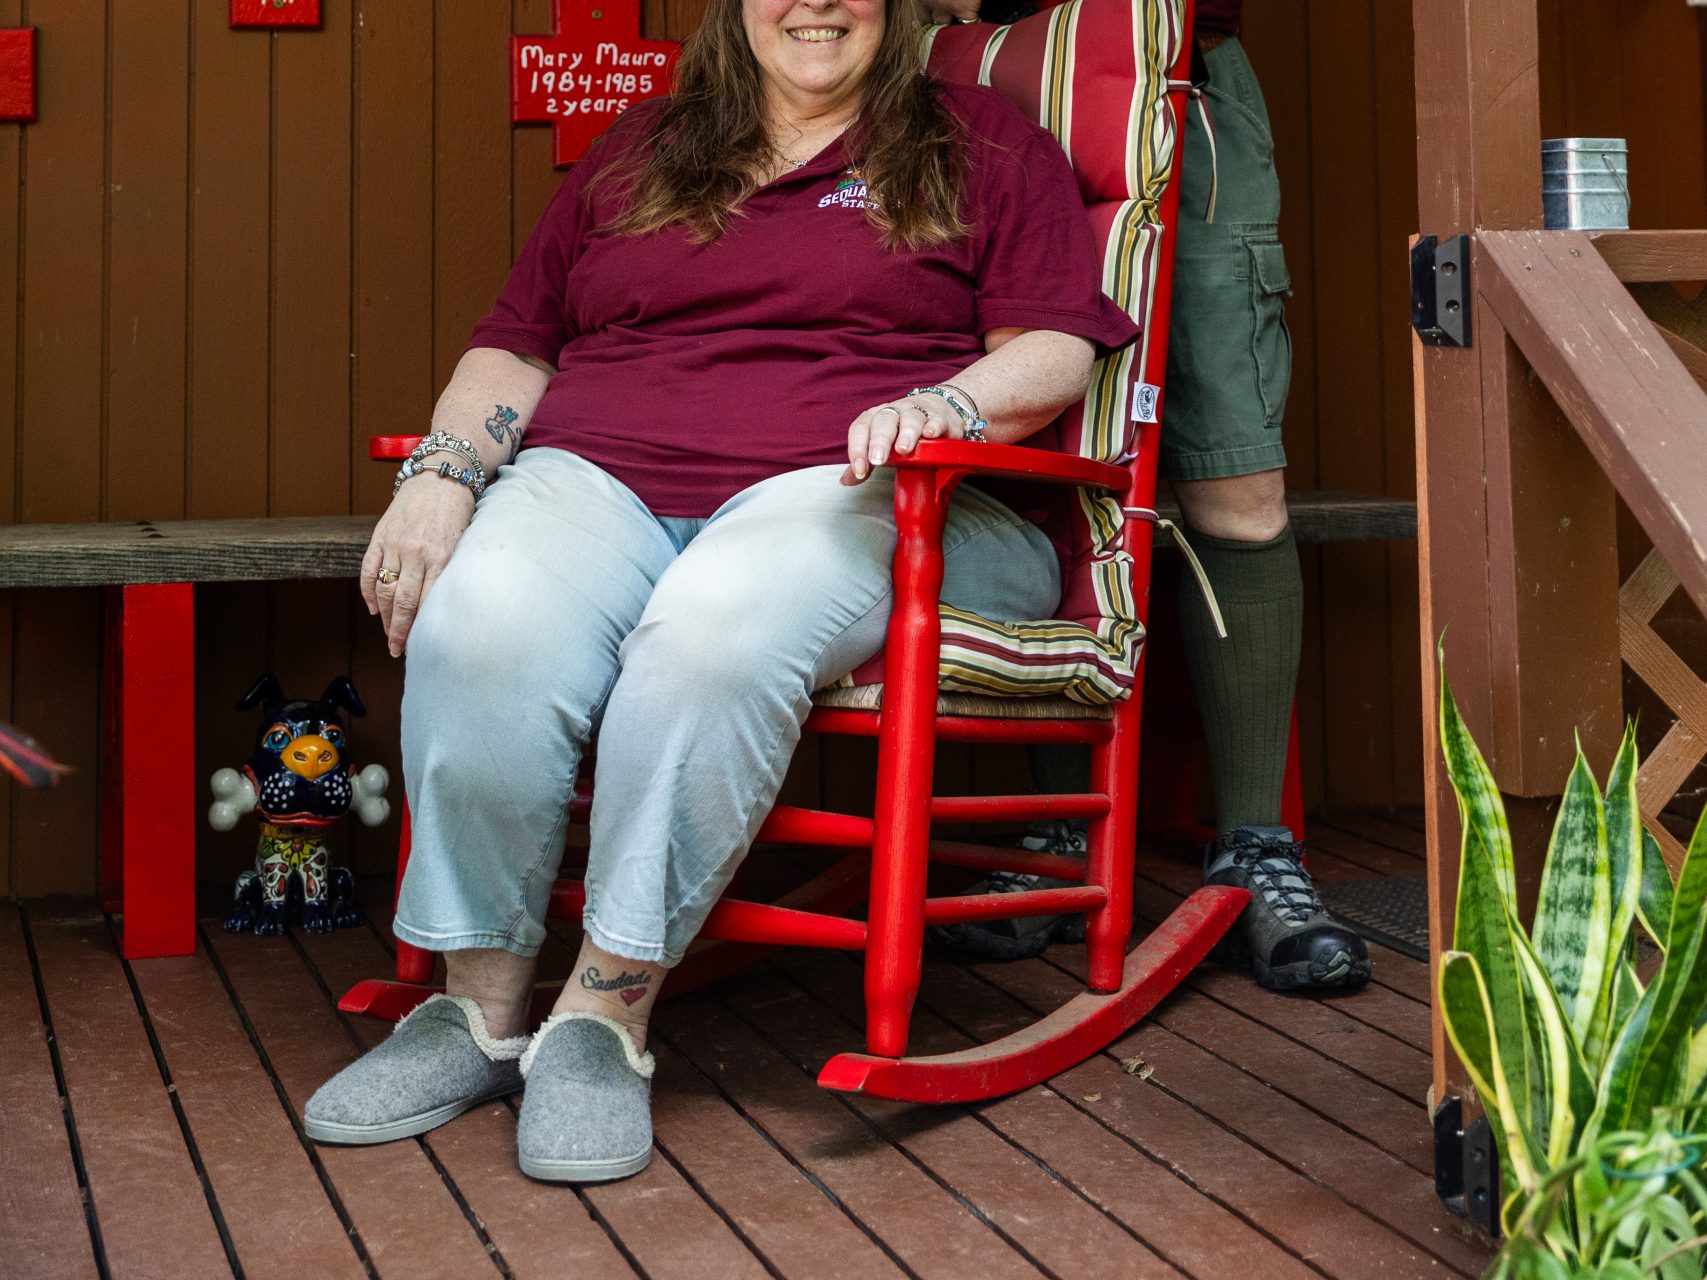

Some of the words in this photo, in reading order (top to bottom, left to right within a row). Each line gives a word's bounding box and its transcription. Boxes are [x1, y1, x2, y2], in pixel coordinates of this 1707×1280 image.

[521, 45, 583, 70] Mary
[596, 43, 667, 67] Mauro
[546, 98, 559, 114] 2
[563, 98, 629, 116] years
[817, 185, 868, 208] SEQUA
